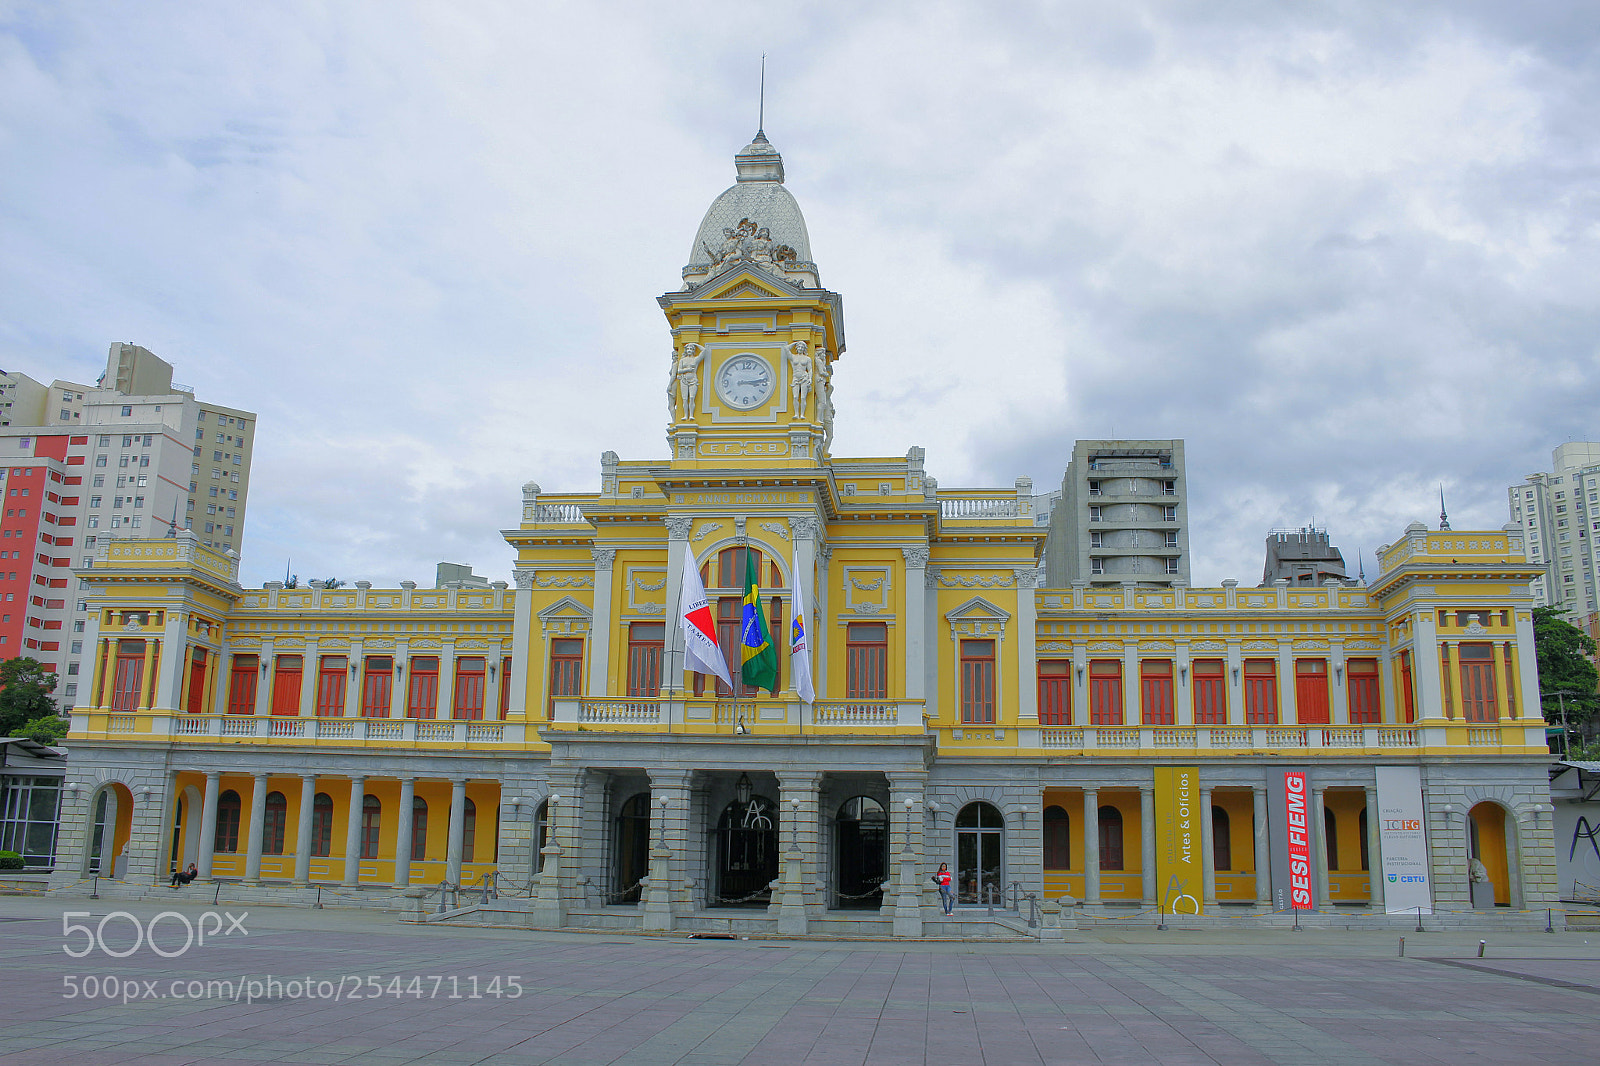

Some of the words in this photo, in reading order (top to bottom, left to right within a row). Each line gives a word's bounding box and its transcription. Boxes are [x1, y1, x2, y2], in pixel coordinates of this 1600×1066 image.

[742, 361, 752, 371] 12
[723, 379, 729, 388] 9
[742, 396, 749, 405] 6
[696, 494, 731, 504] ANNO
[735, 493, 787, 503] MCMXXII
[1286, 776, 1306, 846] FIEMG
[1180, 819, 1190, 829] &
[1180, 832, 1192, 864] Artes
[1290, 853, 1310, 905] SESI
[1400, 875, 1425, 883] CBTU
